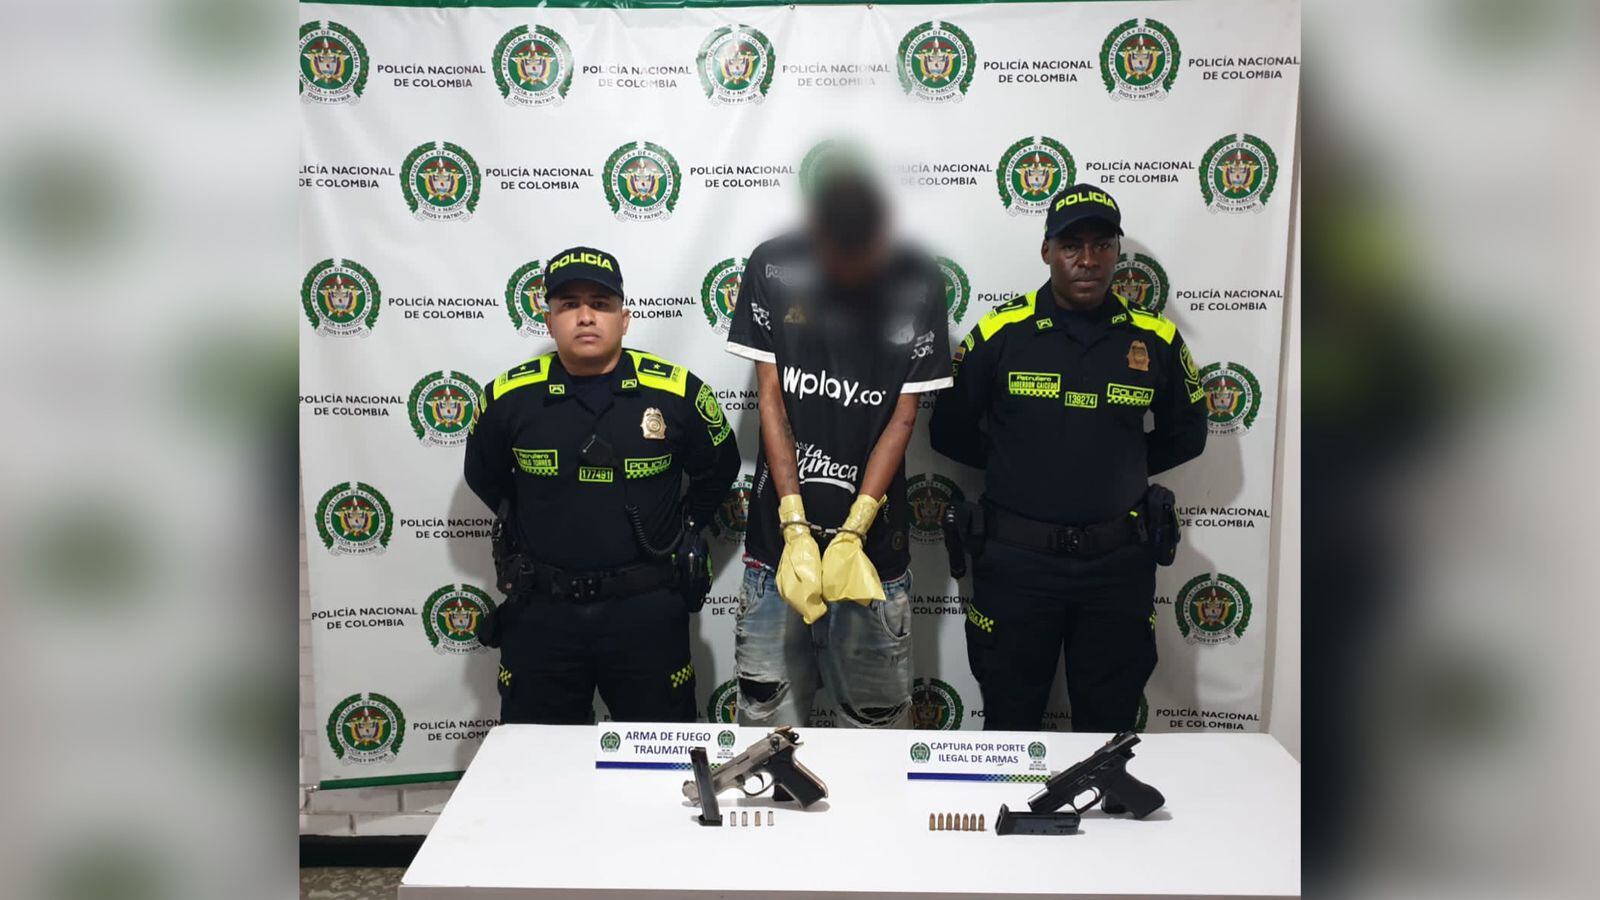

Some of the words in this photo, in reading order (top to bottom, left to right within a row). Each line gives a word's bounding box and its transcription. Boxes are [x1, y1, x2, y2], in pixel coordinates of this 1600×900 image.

[983, 59, 1030, 70] POLICÍA
[1032, 60, 1093, 70] NACIONAL
[1188, 55, 1234, 68] POLICÍA
[1238, 56, 1300, 66] NACIONAL
[377, 63, 425, 75] POLICÍA
[428, 65, 486, 75] NACIONAL
[998, 74, 1014, 84] DE
[1017, 74, 1078, 84] COLOMBIA
[1203, 71, 1219, 81] DE
[1222, 70, 1282, 81] COLOMBIA
[394, 79, 410, 88] DE
[413, 79, 473, 88] COLOMBIA
[616, 78, 678, 89] COLOMBIA
[690, 164, 734, 176] POLICÍA
[737, 165, 796, 175] NACIONAL
[933, 163, 993, 173] NACIONAL
[1085, 158, 1131, 171] POLICÍA
[1134, 161, 1196, 171] NACIONAL
[331, 166, 395, 176] NACIONAL
[485, 166, 530, 178] POLICÍA
[533, 167, 594, 178] NACIONAL
[299, 178, 313, 188] DE
[316, 178, 380, 189] COLOMBIA
[705, 179, 720, 189] DE
[722, 178, 781, 189] COLOMBIA
[917, 176, 978, 186] COLOMBIA
[1100, 174, 1116, 184] DE
[1118, 174, 1179, 184] COLOMBIA
[501, 180, 516, 190] DE
[518, 180, 580, 190] COLOMBIA
[1055, 191, 1118, 213] POLICÍA
[549, 251, 614, 274] POLICÍA
[1176, 288, 1221, 300] POLICÍA
[1224, 289, 1283, 299] NACIONAL
[388, 295, 435, 307] POLICÍA
[437, 298, 499, 307] NACIONAL
[638, 297, 697, 306] NACIONAL
[1190, 302, 1205, 311] DE
[1207, 302, 1267, 311] COLOMBIA
[404, 310, 420, 319] DE
[422, 310, 485, 319] COLOMBIA
[1111, 387, 1150, 399] POLICÍA
[345, 395, 404, 405] NACIONAL
[314, 407, 329, 416] DE
[332, 407, 390, 417] COLOMBIA
[805, 443, 823, 459] La
[1210, 507, 1270, 519] NACIONAL
[400, 517, 444, 528] POLICÍA
[448, 518, 493, 528] NACION
[1195, 518, 1255, 529] COLOMBIA
[416, 531, 430, 539] DE
[311, 606, 356, 620] POLICÍA
[359, 606, 418, 617] NACIONAL
[712, 607, 726, 616] DE
[327, 621, 342, 630] DE
[345, 618, 404, 629] COLOMBIA
[1156, 706, 1199, 718] POLICÍA
[1201, 710, 1260, 722] NACIONAL
[413, 719, 456, 731] POLICÍA
[1169, 719, 1182, 729] DE
[1187, 719, 1244, 731] COLOMBIA
[428, 733, 442, 741] DE
[625, 731, 658, 741] ARMA
[660, 731, 673, 741] DE
[676, 732, 711, 742] FUEGO
[634, 744, 694, 755] TRAUMATIC
[930, 742, 973, 751] CAPTURA
[975, 742, 994, 752] POR
[996, 743, 1026, 753] PORTE
[938, 754, 969, 763] ILEGAL
[971, 754, 984, 763] DE
[985, 754, 1019, 764] ARMAS
